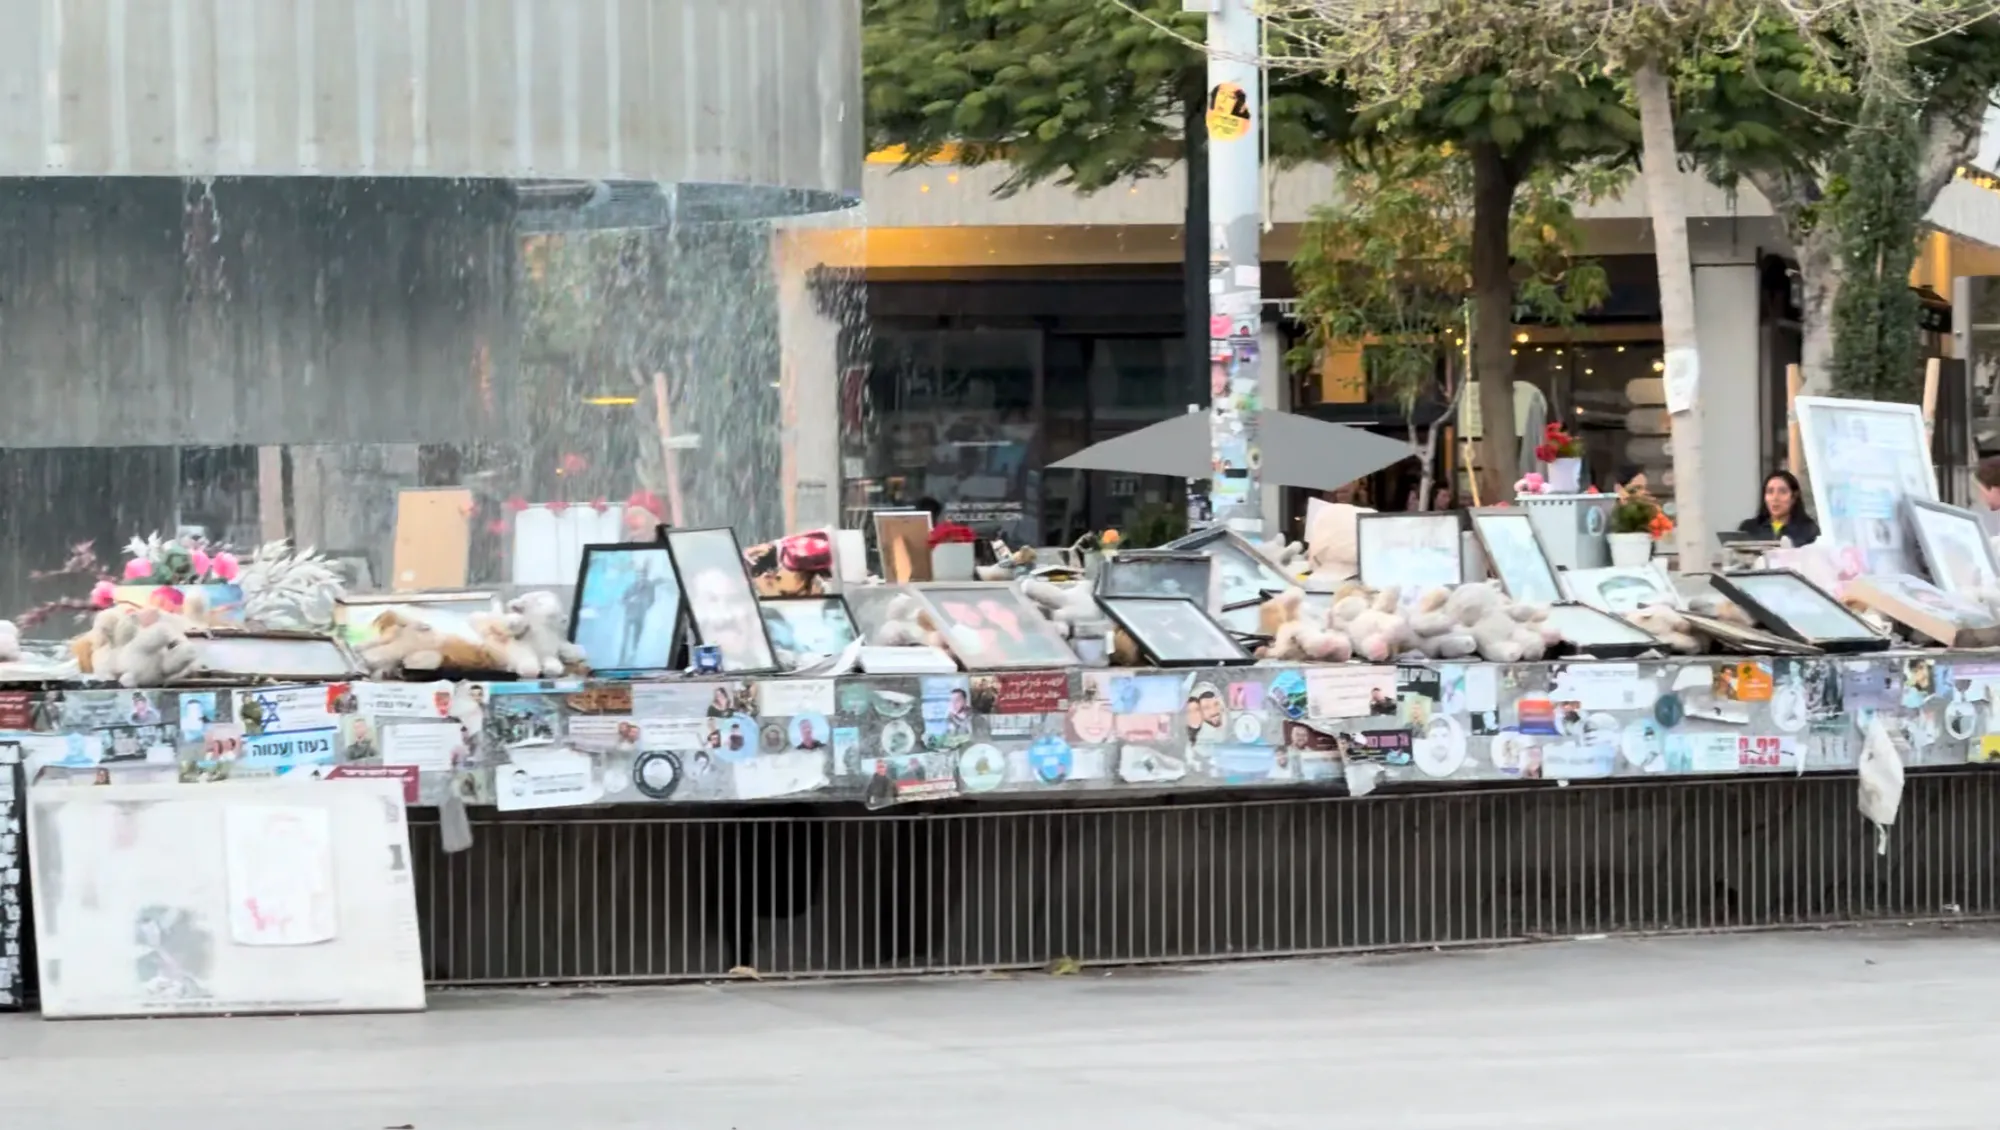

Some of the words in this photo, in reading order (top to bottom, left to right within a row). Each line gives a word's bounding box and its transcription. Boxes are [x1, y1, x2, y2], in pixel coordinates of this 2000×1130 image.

[945, 512, 1023, 521] COLLECTION
[252, 741, 293, 757] וענווה
[298, 739, 329, 753] בעוז
